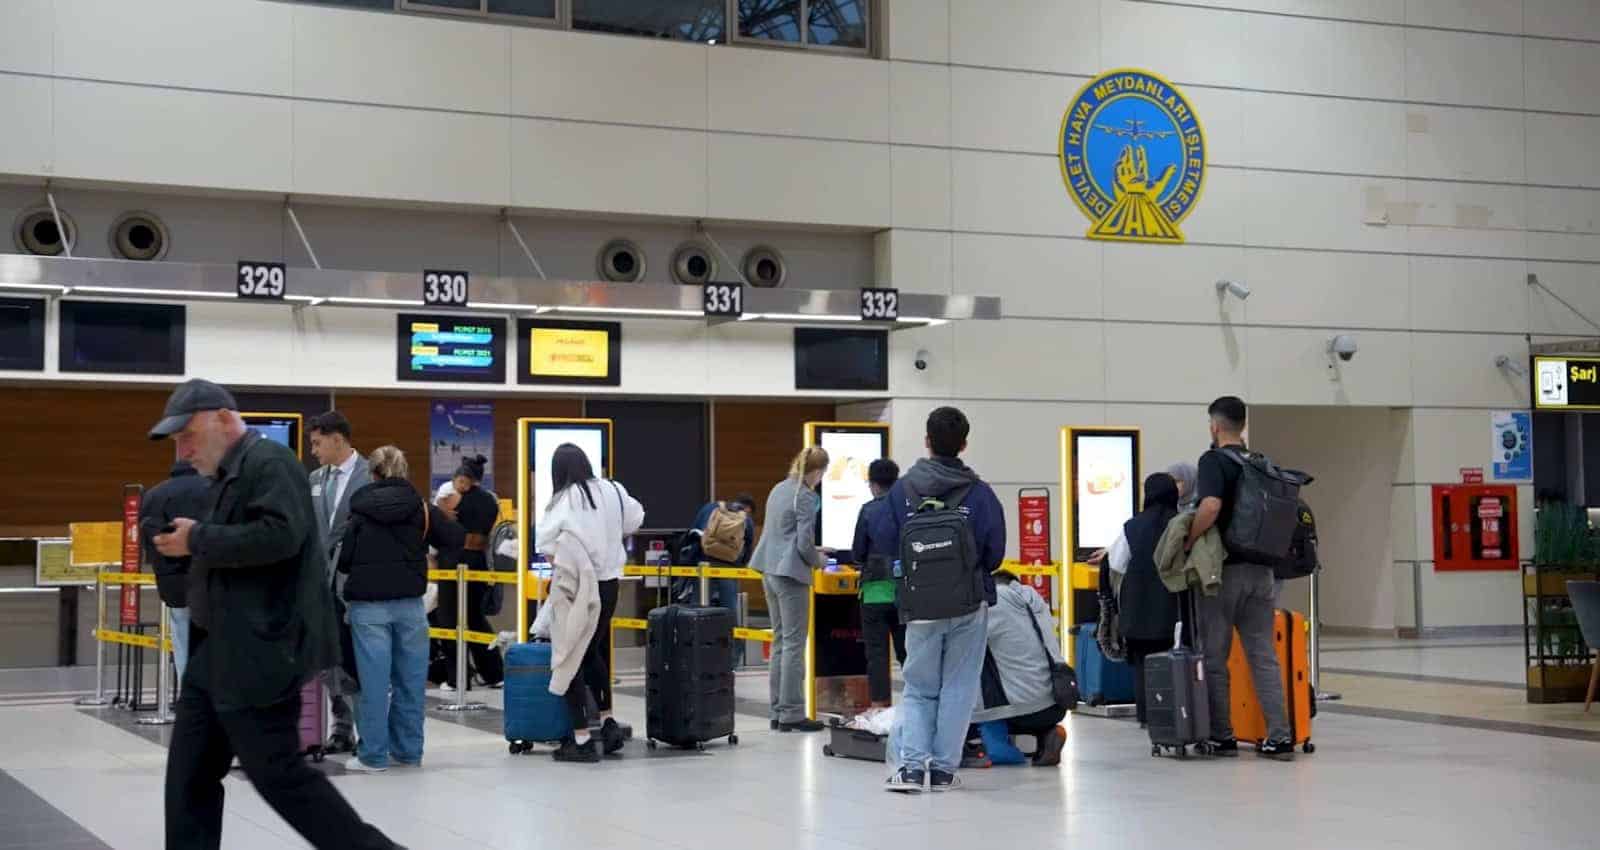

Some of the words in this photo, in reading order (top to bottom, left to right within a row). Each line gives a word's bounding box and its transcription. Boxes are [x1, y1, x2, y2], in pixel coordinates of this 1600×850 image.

[1093, 76, 1191, 122] MEYDANLARI
[1067, 101, 1094, 145] HAVA
[1068, 153, 1107, 214] DEVLET
[239, 265, 285, 296] 329
[424, 273, 467, 302] 330
[706, 285, 741, 313] 331
[862, 291, 897, 318] 332
[1570, 365, 1597, 383] Şarj
